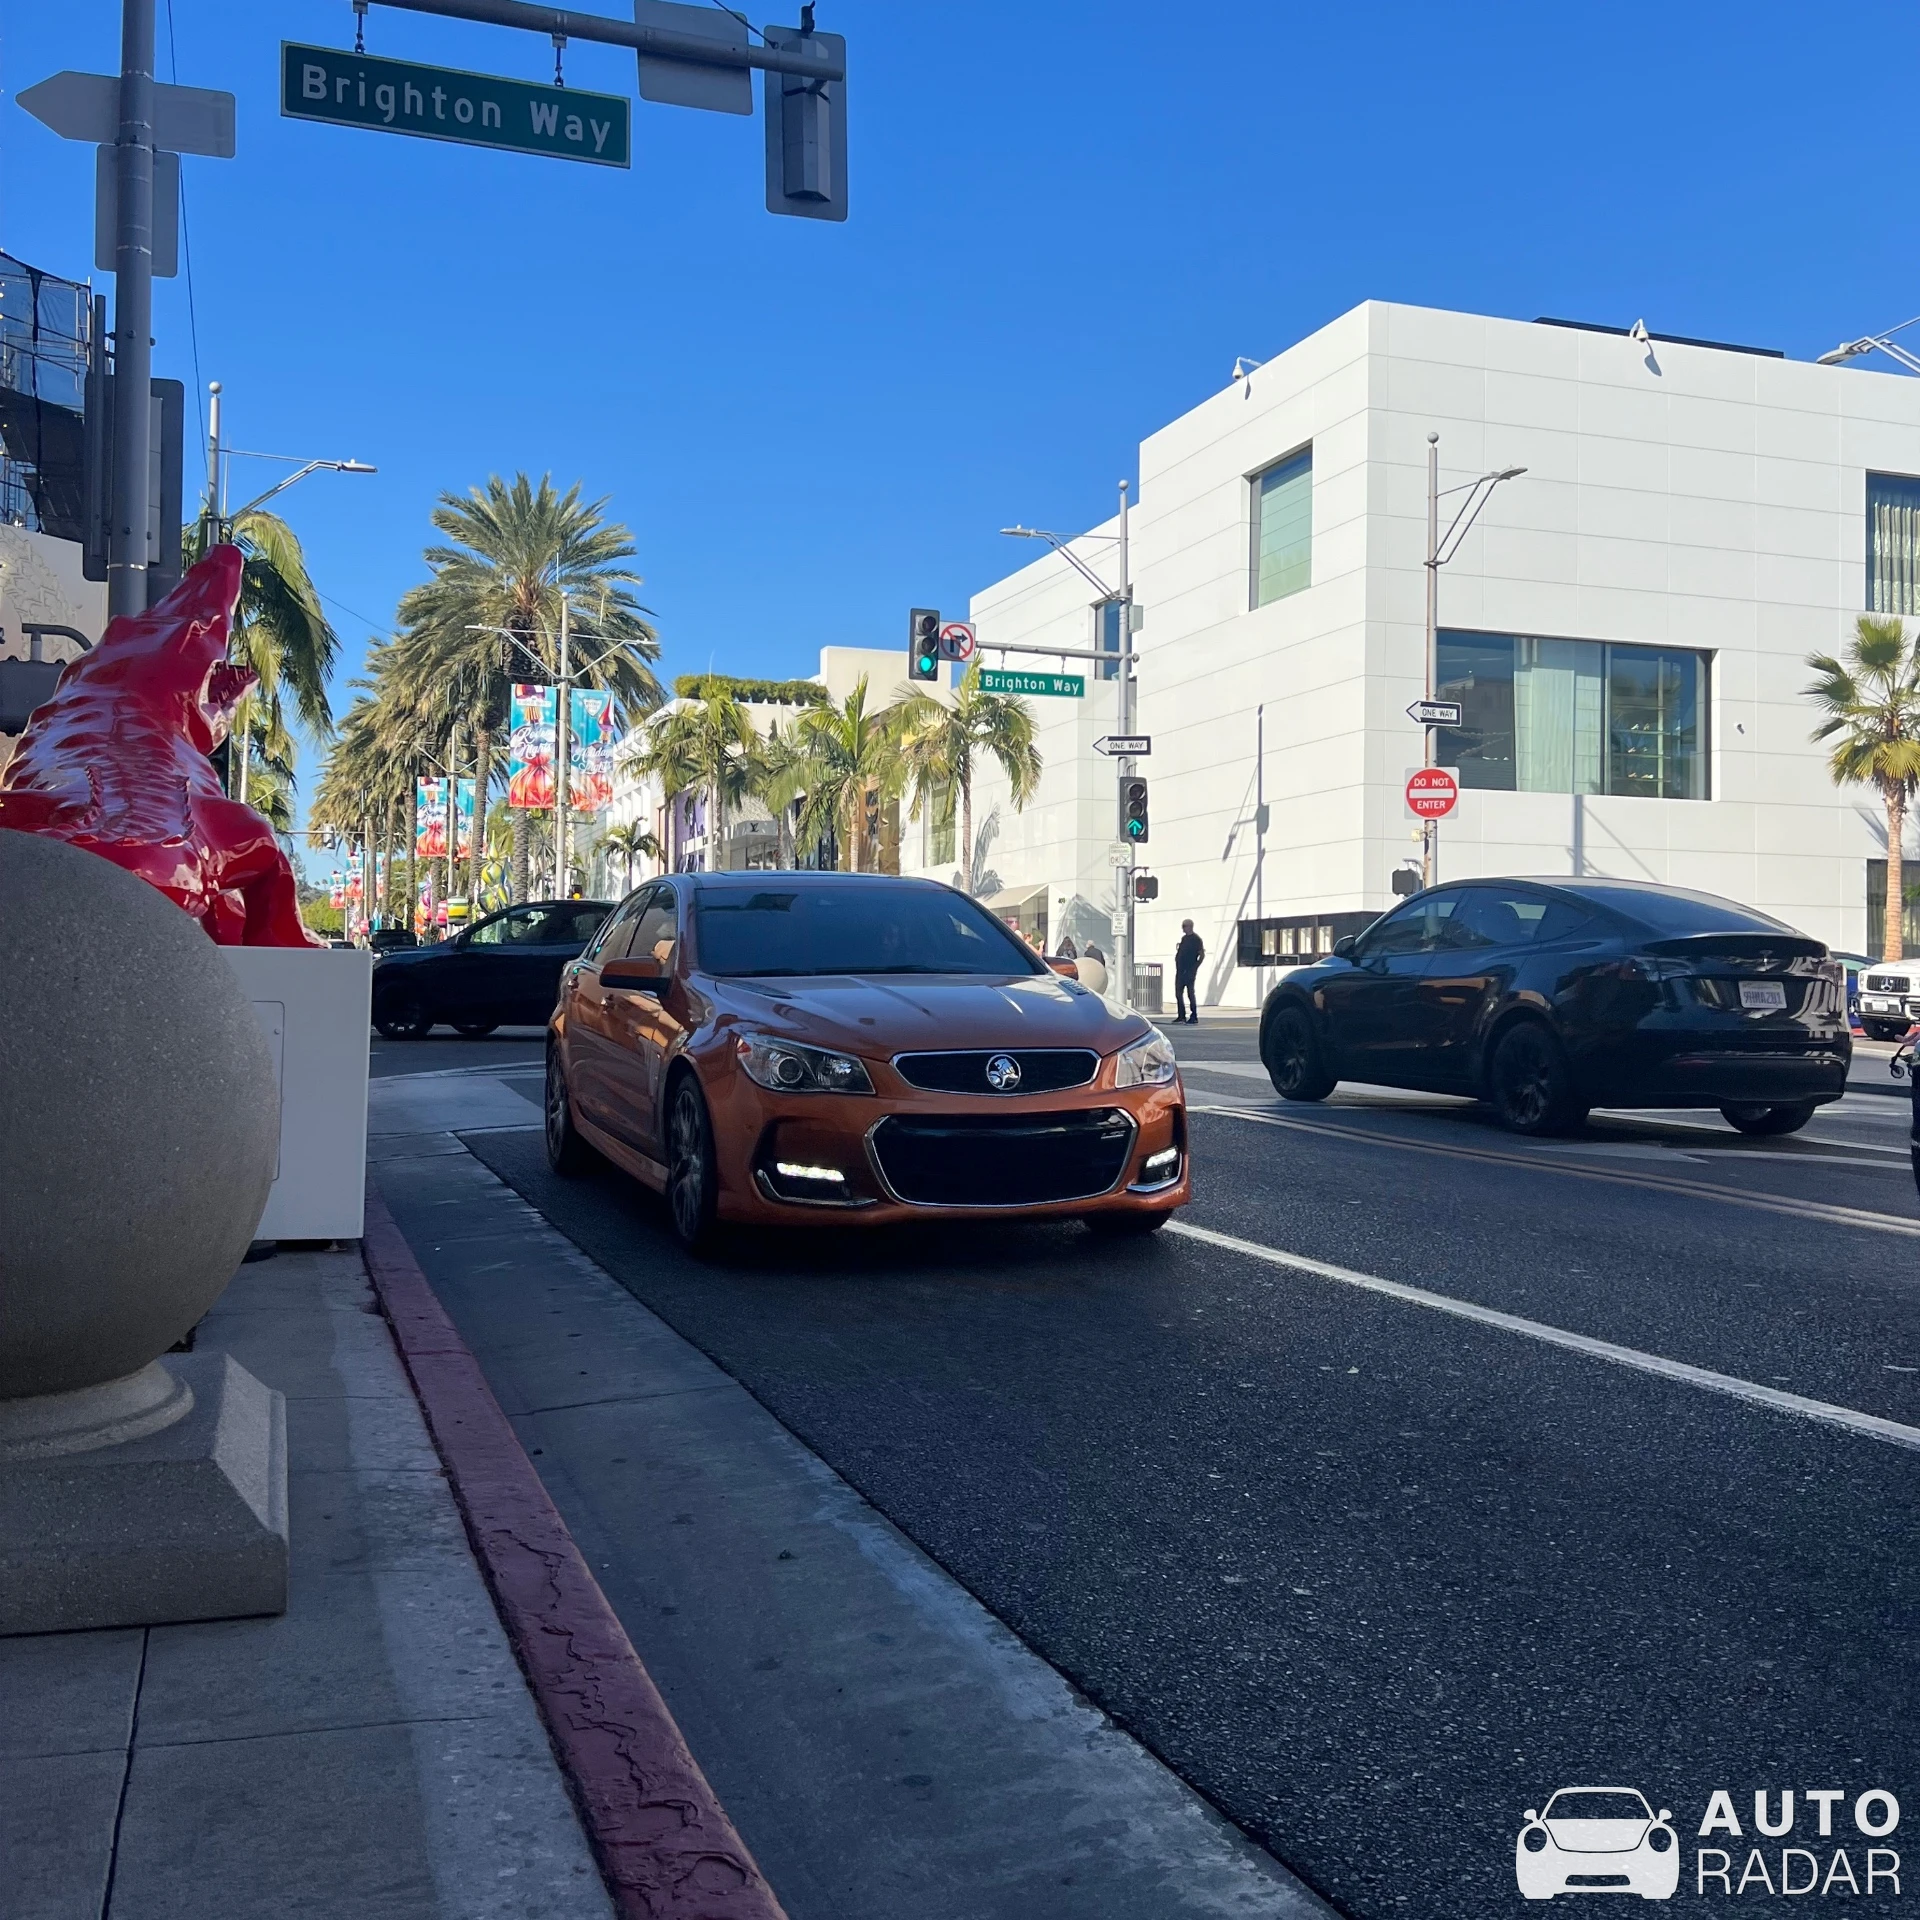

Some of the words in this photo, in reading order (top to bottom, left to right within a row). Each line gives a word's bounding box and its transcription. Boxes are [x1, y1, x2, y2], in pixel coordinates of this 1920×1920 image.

[302, 63, 501, 128] Brighton
[529, 100, 611, 153] Way
[985, 674, 1046, 692] Brighton
[1053, 678, 1080, 695] Way
[1421, 707, 1437, 718] ONE
[1439, 708, 1454, 719] WAY
[1109, 741, 1125, 750] ONE
[1128, 741, 1144, 750] WAY
[1413, 777, 1427, 787] DO
[1431, 777, 1450, 787] NOT
[1416, 800, 1446, 810] ENTER
